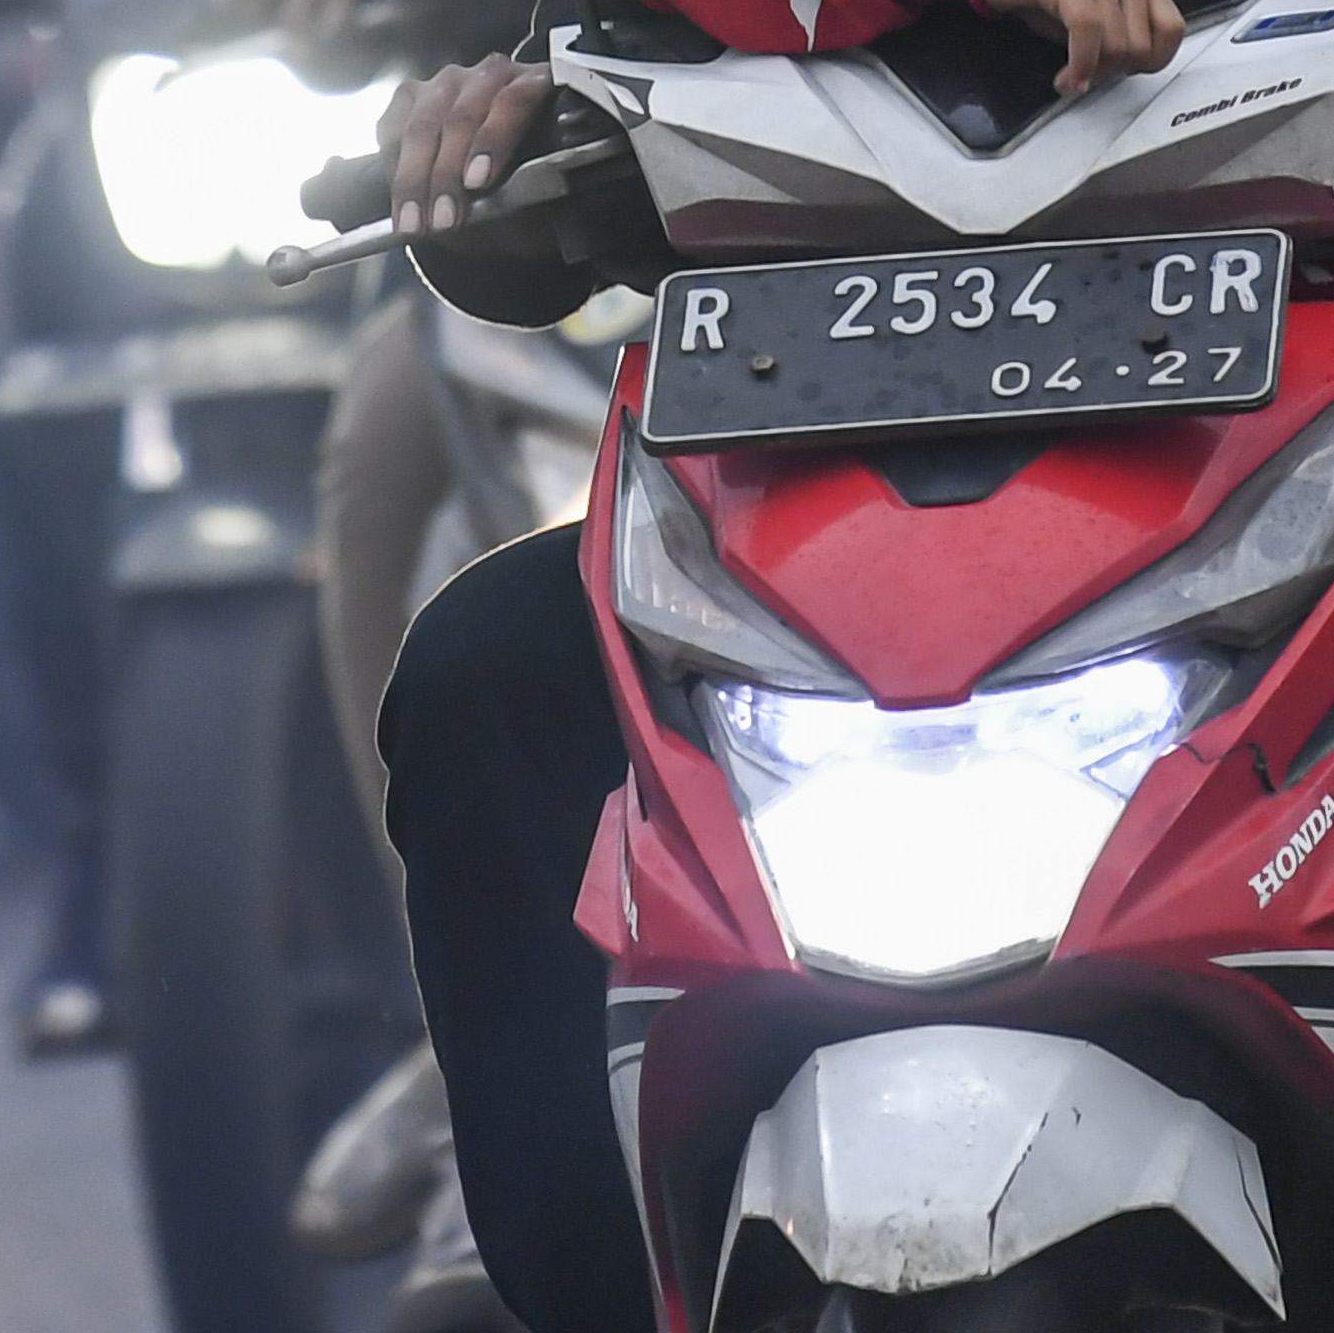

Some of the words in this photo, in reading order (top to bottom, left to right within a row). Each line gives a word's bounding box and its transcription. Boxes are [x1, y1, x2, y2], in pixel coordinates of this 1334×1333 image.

[1170, 95, 1238, 127] Combi
[1240, 77, 1302, 104] Brake
[679, 287, 730, 352] R
[828, 263, 1058, 340] 2534
[1150, 248, 1263, 317] CR
